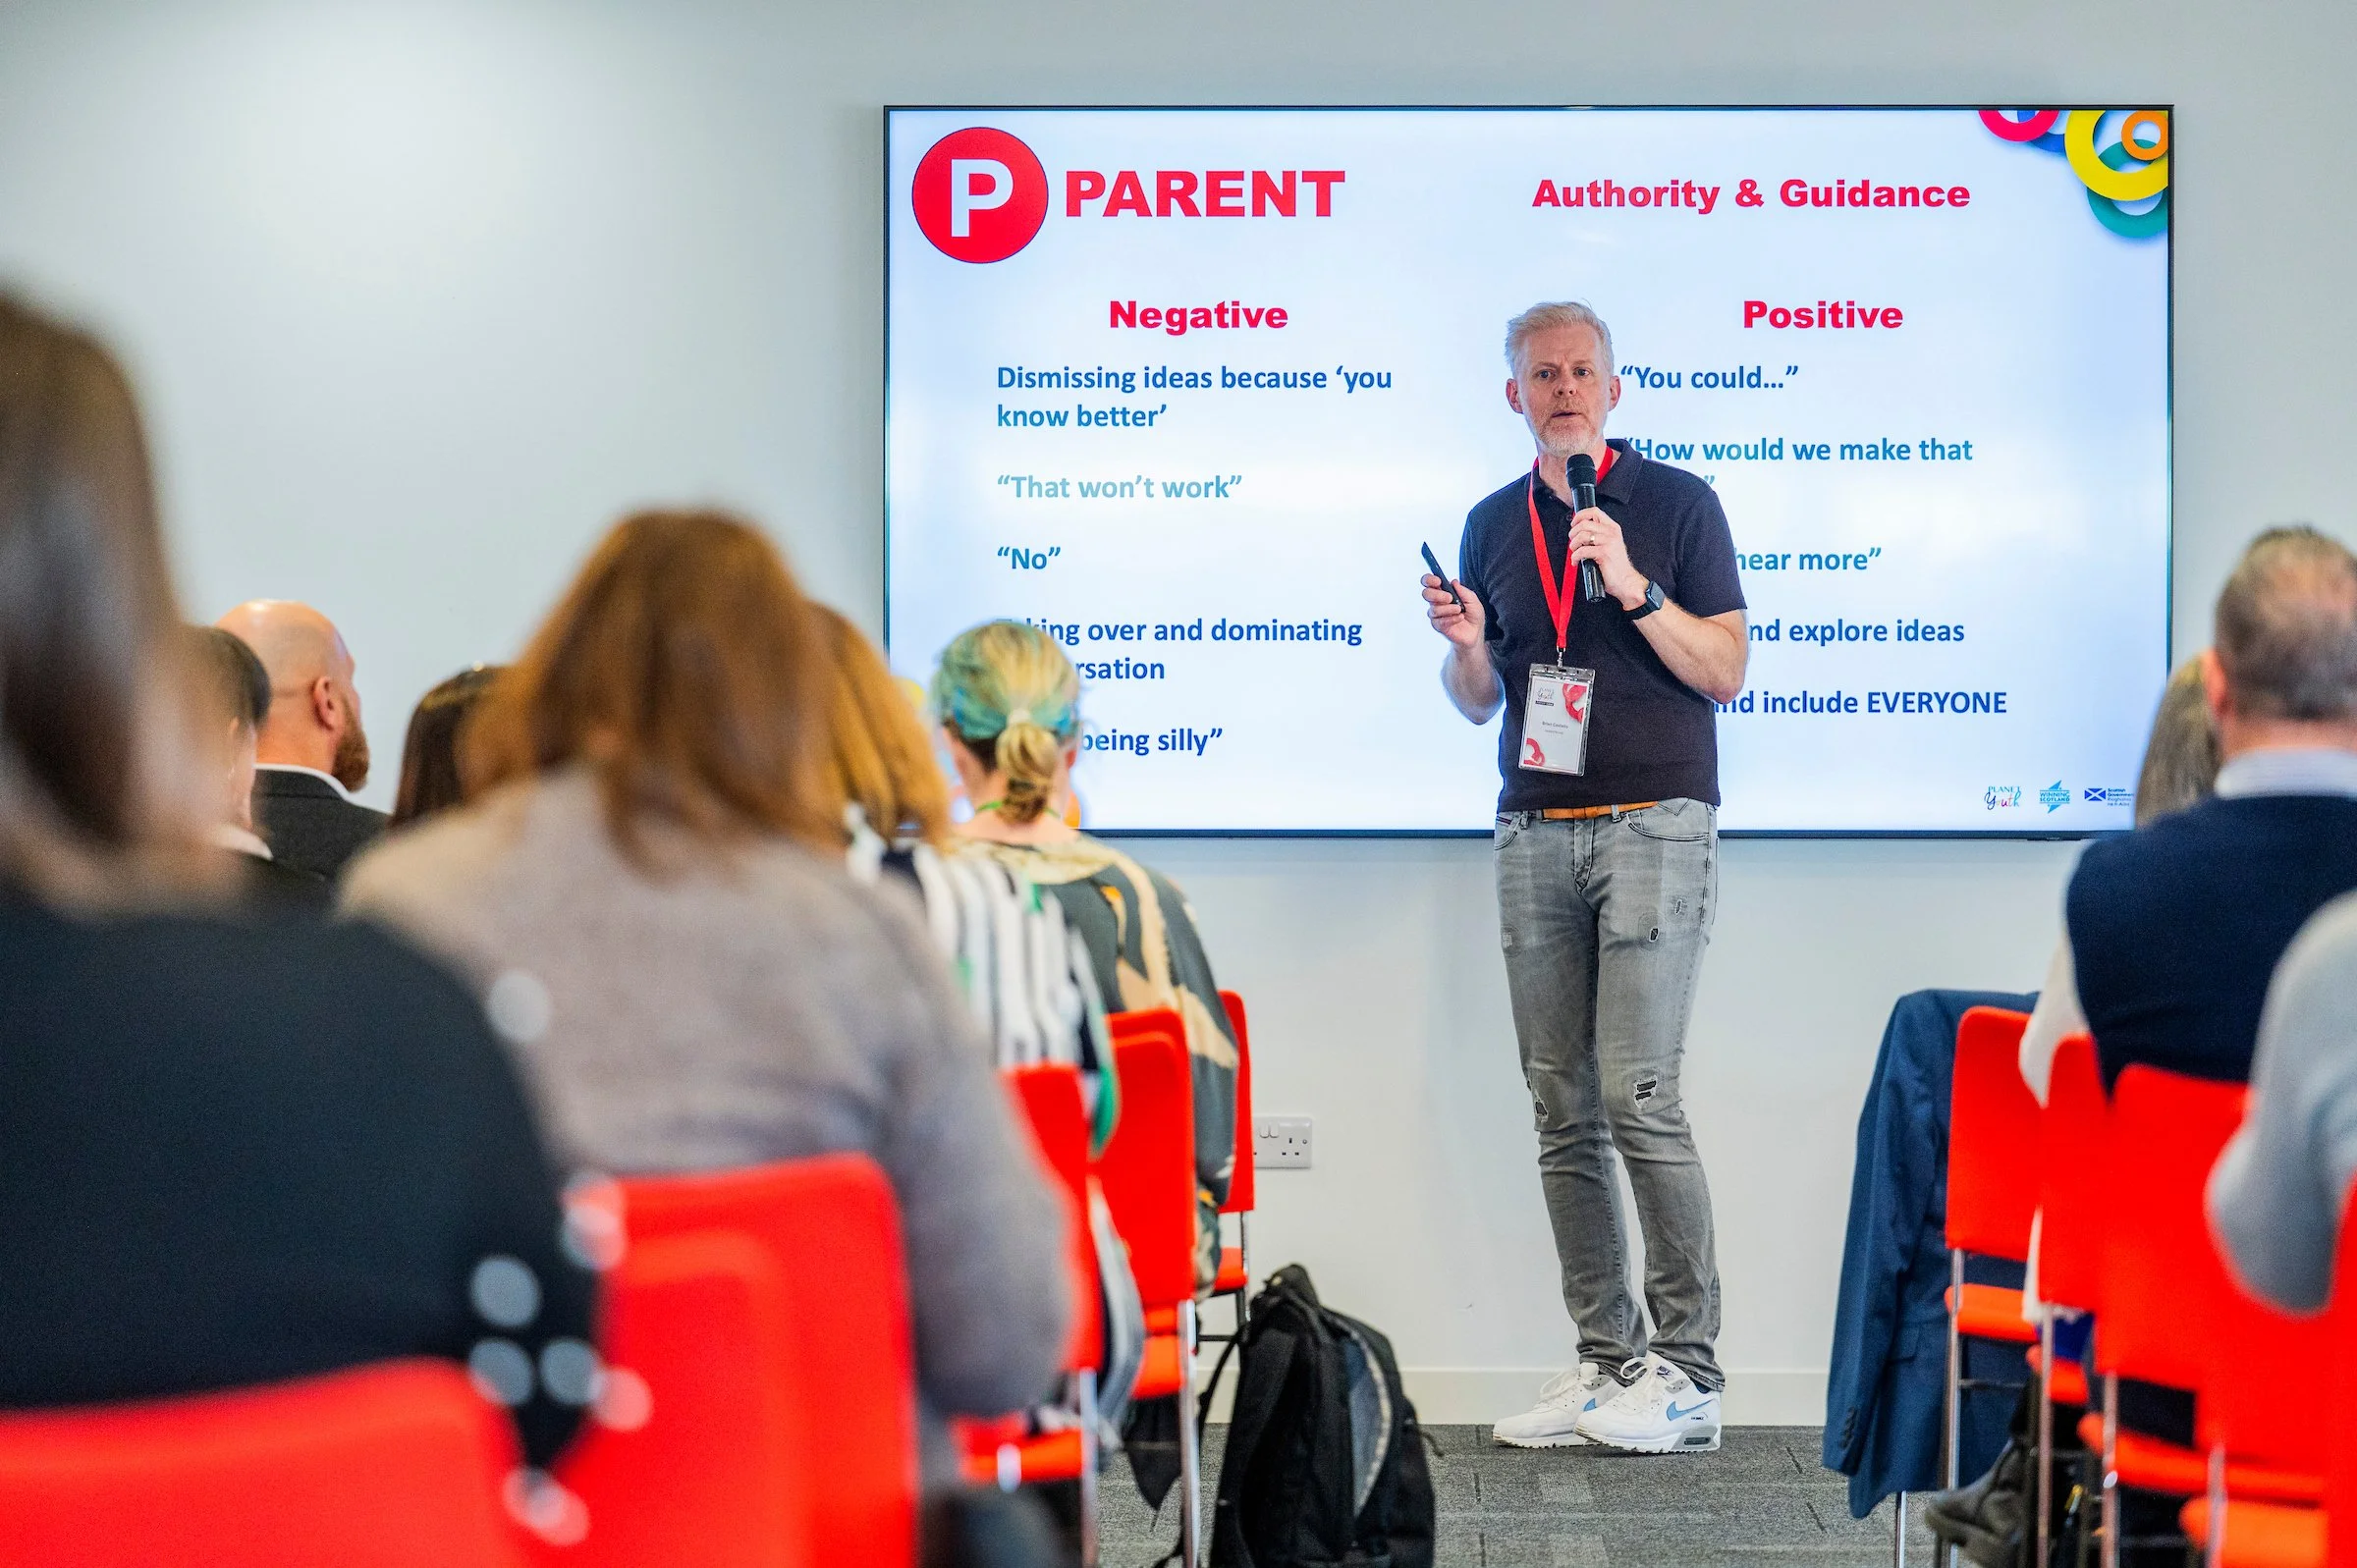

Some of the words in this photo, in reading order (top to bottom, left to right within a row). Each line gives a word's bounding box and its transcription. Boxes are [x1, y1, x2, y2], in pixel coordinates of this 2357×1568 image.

[951, 158, 1014, 238] P
[1066, 170, 1345, 217] PARENT
[1532, 179, 1721, 215] Authority
[1735, 179, 1764, 208] &
[1779, 179, 1971, 208] Guidance
[1110, 300, 1288, 336] Negative
[1743, 300, 1903, 329] Positive
[997, 365, 1135, 394] Dismissing
[1143, 365, 1212, 389] ideas
[1222, 365, 1327, 389] because
[1336, 365, 1392, 394] ‘you
[1620, 365, 1681, 389] “You
[997, 404, 1069, 427] know
[1077, 404, 1167, 427] better’
[1701, 437, 1783, 460] would
[1791, 444, 1831, 460] we
[1839, 437, 1911, 460] make
[1918, 438, 1974, 460] that
[997, 475, 1069, 498] “That
[1077, 475, 1155, 498] won’t
[1162, 475, 1241, 498] work”
[997, 546, 1061, 569] “No”
[1799, 547, 1881, 570] more”
[1088, 624, 1147, 641] over
[1154, 618, 1202, 641] and
[1211, 618, 1362, 646] dominating
[1748, 619, 1780, 641] nd
[1789, 619, 1888, 647] explore
[1897, 619, 1965, 642] ideas
[1075, 657, 1165, 679] rsation
[1764, 690, 1858, 714] include
[1868, 691, 2006, 714] EVERYONE
[1158, 728, 1223, 756] silly”
